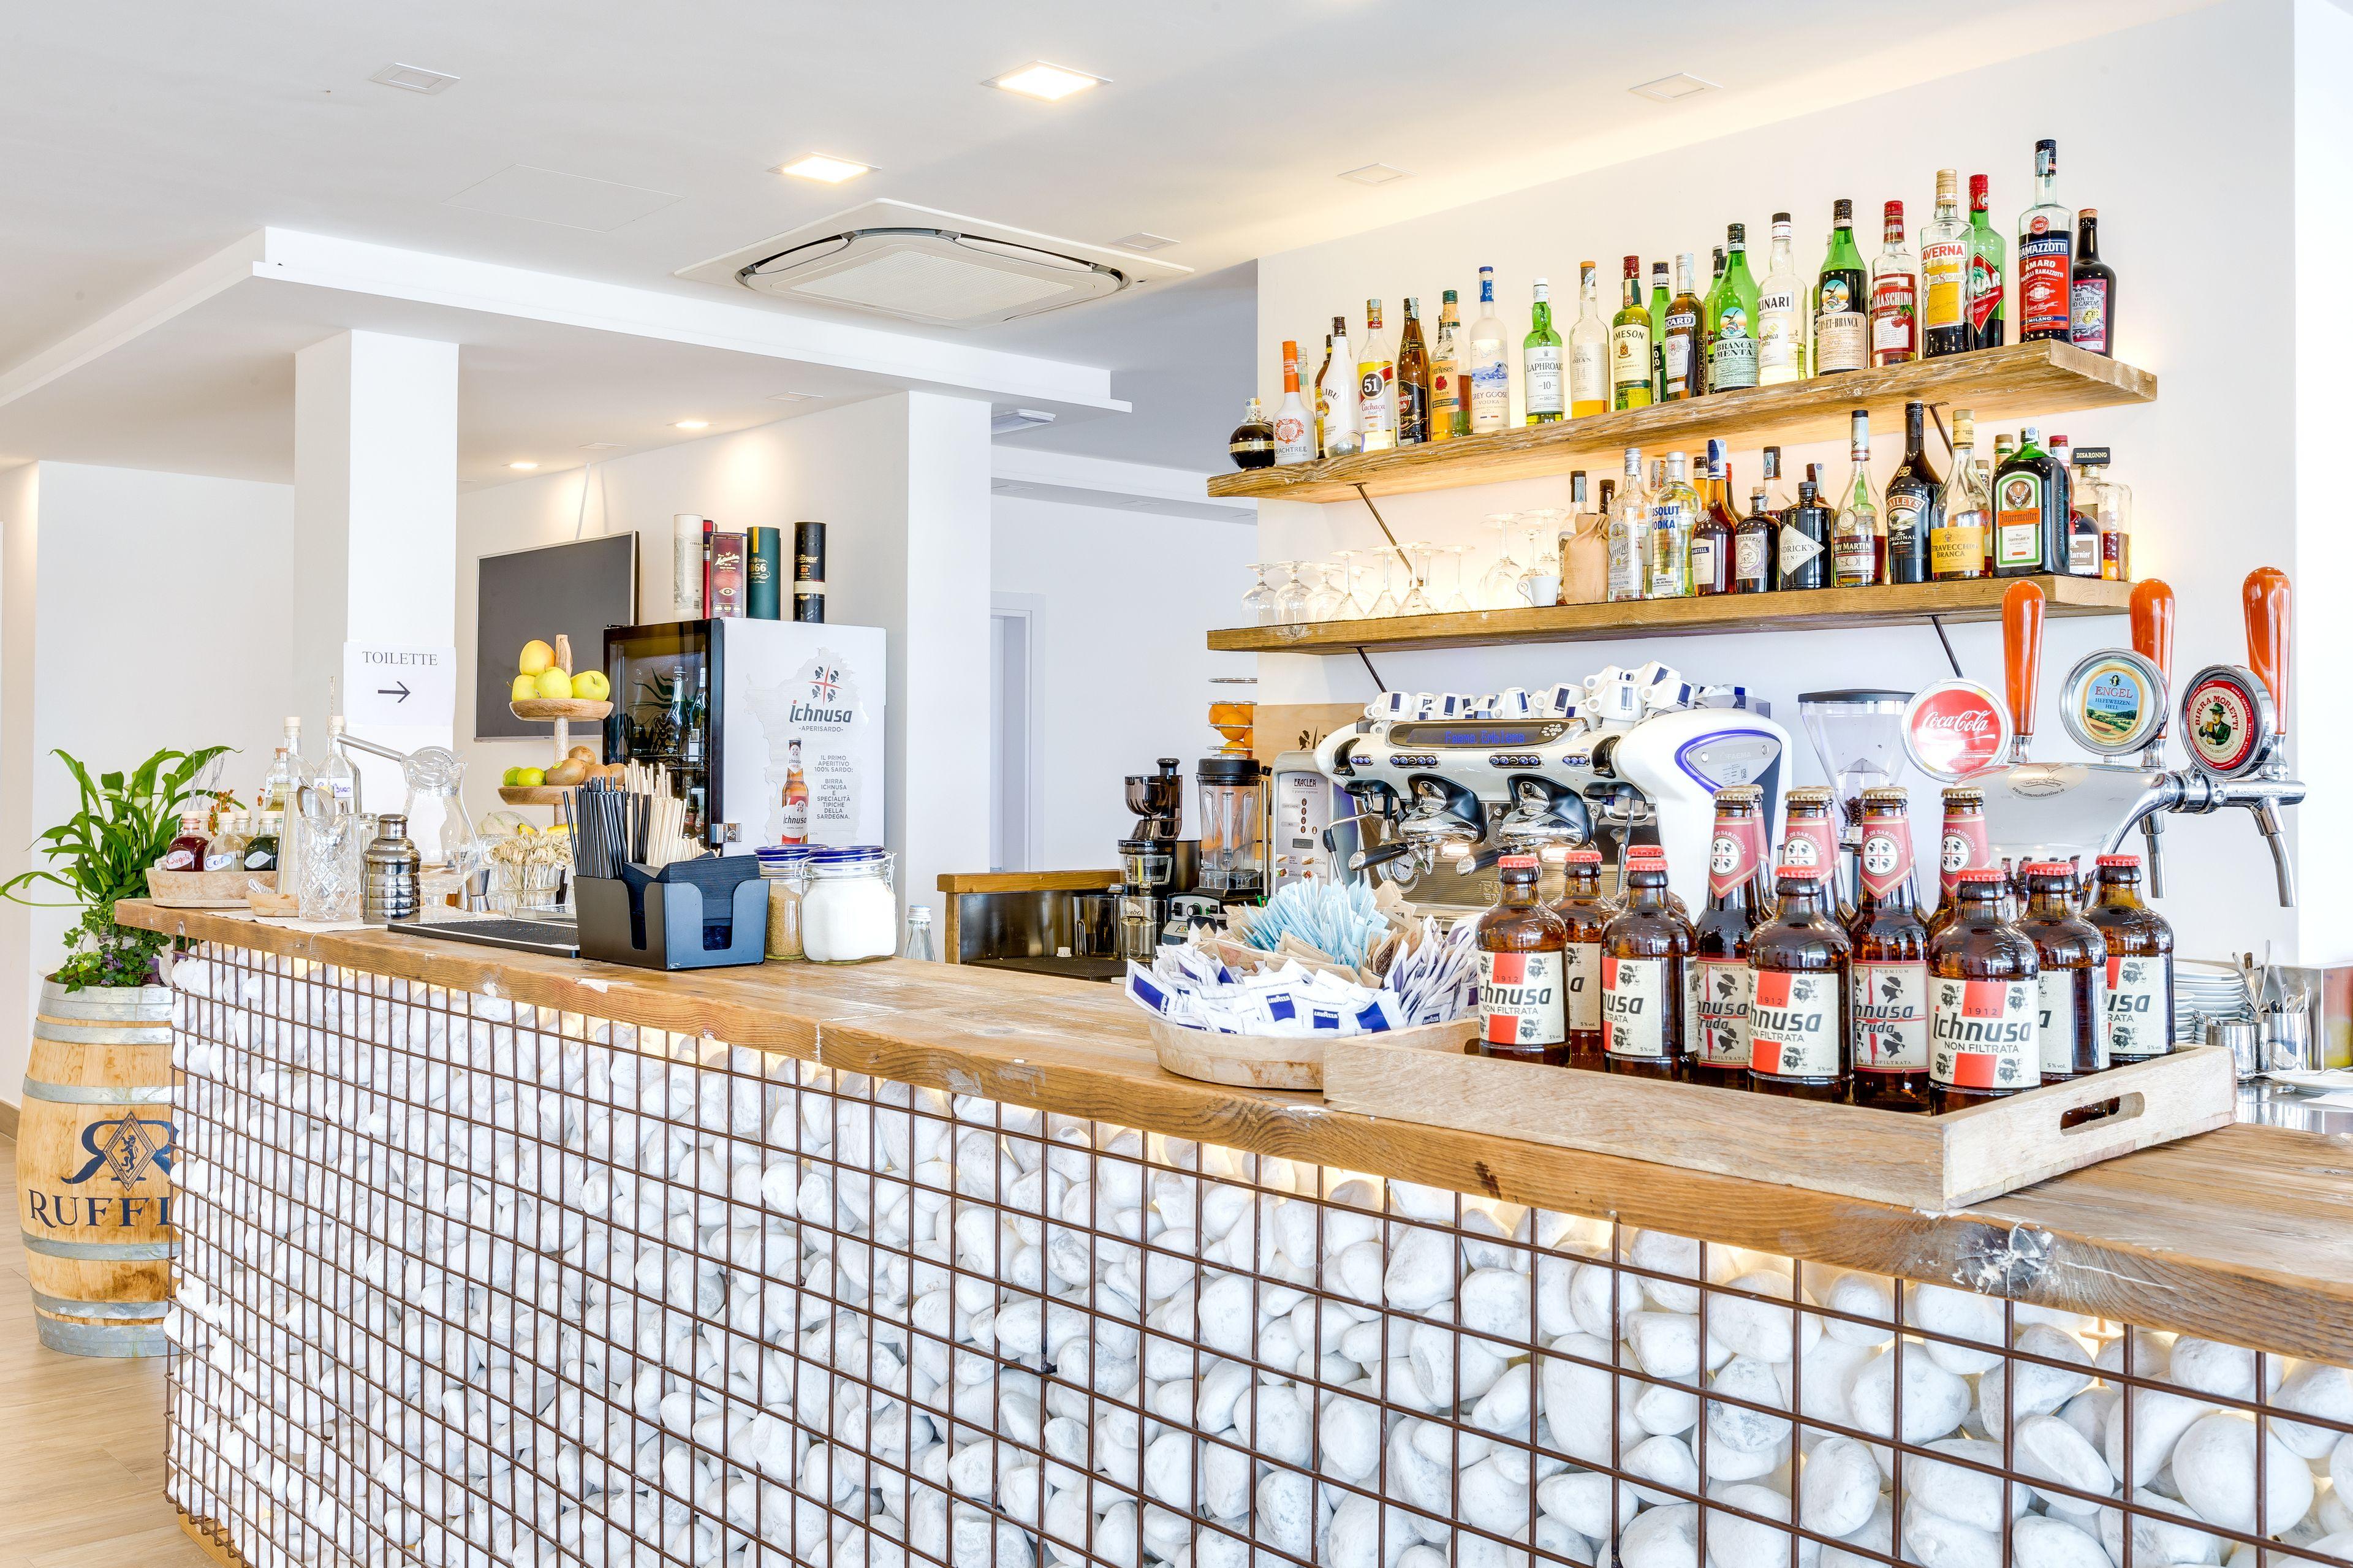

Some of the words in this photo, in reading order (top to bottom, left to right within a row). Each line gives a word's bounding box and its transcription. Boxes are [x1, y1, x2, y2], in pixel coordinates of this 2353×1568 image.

[1922, 245, 1964, 262] AVERNA
[2020, 243, 2066, 259] RAMAZZOTTI
[2025, 260, 2056, 272] AMARO
[2034, 269, 2064, 278] RAMAZZOTTI
[1613, 330, 1645, 341] AMESON
[1716, 342, 1752, 350] BRANCA
[1716, 349, 1752, 358] MENTA
[1364, 377, 1379, 392] 51
[1543, 381, 1551, 390] 10
[1362, 402, 1385, 412] Cachaça
[1843, 542, 1870, 550] MARTIN
[749, 563, 766, 572] 1866
[362, 651, 439, 665] TOILETTE
[2094, 686, 2133, 699] ENGEL
[2095, 697, 2131, 706] HEFEWEIZEN
[789, 700, 853, 723] ichnusa
[2195, 697, 2212, 726] BIRRA
[2213, 695, 2239, 731] MORETTI
[1922, 710, 1992, 732] Coca-Cola
[1445, 730, 1476, 744] Faema
[1480, 729, 1525, 744] Emblema
[2214, 740, 2235, 754] ORIGINALE
[1727, 751, 1751, 760] FAEMA
[1294, 778, 1316, 787] ERACLEA
[1721, 830, 1746, 854] SARDEGNA
[1796, 831, 1824, 856] SARDEGNA
[1876, 830, 1903, 854] SARDEGNA
[1950, 828, 1977, 852] SARDEGNA
[1479, 979, 1552, 1006] chnusa
[1267, 994, 1290, 1004] LAVAZZA
[1760, 996, 1783, 1006] 1912
[1498, 1006, 1539, 1015] FILTRATA
[1854, 999, 1915, 1019] hnusa
[1968, 1007, 1998, 1016] 1912
[1423, 1015, 1439, 1024] LAVAZZA
[1700, 1017, 1729, 1030] ruda
[1933, 1005, 2032, 1042] ichnusa
[2108, 1013, 2134, 1022] RATA
[1760, 1031, 1805, 1042] FILTRATA
[1944, 1040, 1966, 1051] NON
[1969, 1044, 2020, 1053] FILTRATA
